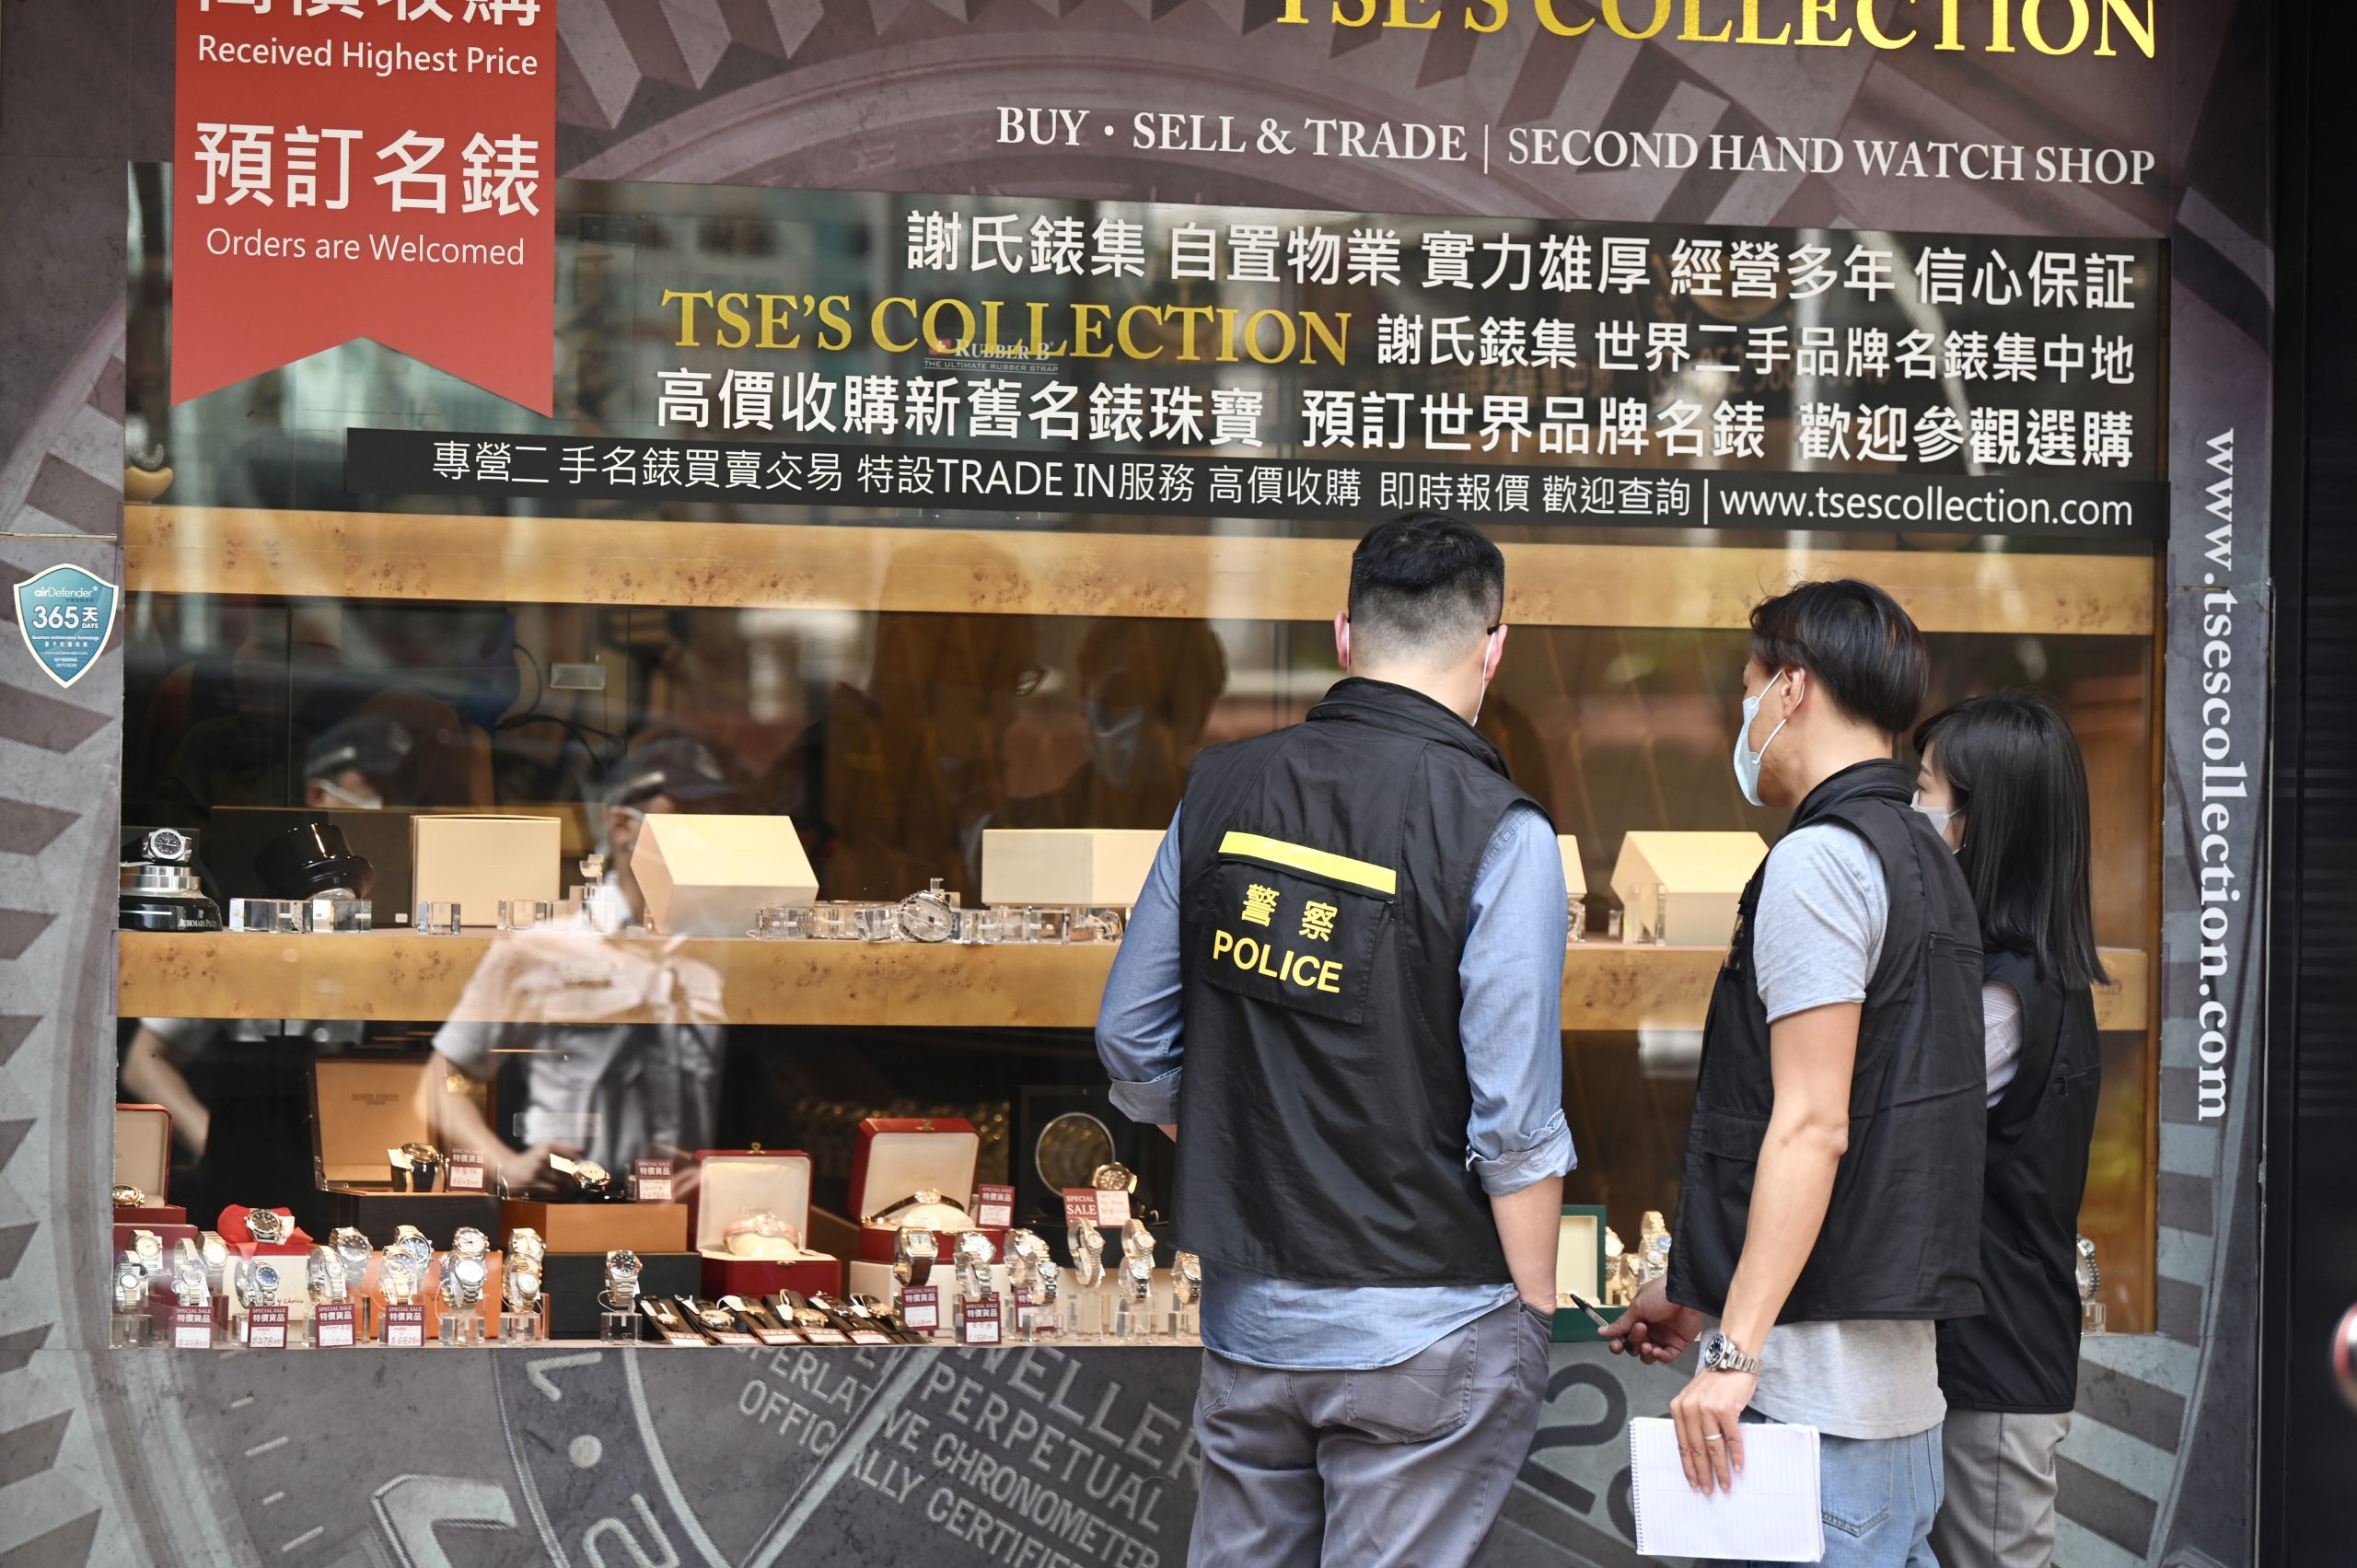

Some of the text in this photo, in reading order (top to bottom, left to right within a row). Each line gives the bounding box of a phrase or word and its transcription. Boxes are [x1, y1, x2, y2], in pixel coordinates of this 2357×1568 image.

[199, 35, 538, 77] Received Highest Price
[194, 122, 540, 217] 預訂名錶
[996, 106, 2155, 185] BUY SELL & TRADE SECOND HAND WATCH SHOP
[206, 227, 525, 266] Orders are Welcomed
[907, 210, 2136, 313] 謝氏錶集 自置物業 實力雄厚 經營多年 信心保証
[870, 296, 1352, 366] COLLECTION
[1377, 312, 1578, 369] 謝氏錶集
[1595, 321, 2136, 386] 世界二手品牌名錶集中地
[955, 338, 1029, 360] RUBBER
[990, 363, 1028, 372] RUBBER
[1029, 365, 1059, 373] STRAP
[656, 367, 2134, 470] 高價收購新舊名錶珠寶 預訂世界品牌名錶 歡迎參觀選購
[1208, 466, 1362, 507] 高價收購
[1380, 471, 1531, 514] 即時報價
[1719, 485, 2134, 528] www.tsescollection.com
[32, 605, 99, 630] 365 天
[35, 587, 93, 598] airDefender
[2199, 427, 2247, 1121] www.tsescollection.com
[1240, 883, 1338, 943] 警察
[1213, 929, 1344, 993] POLICE
[1066, 1204, 1097, 1215] SALE
[921, 1361, 1161, 1533] PERPETUAL
